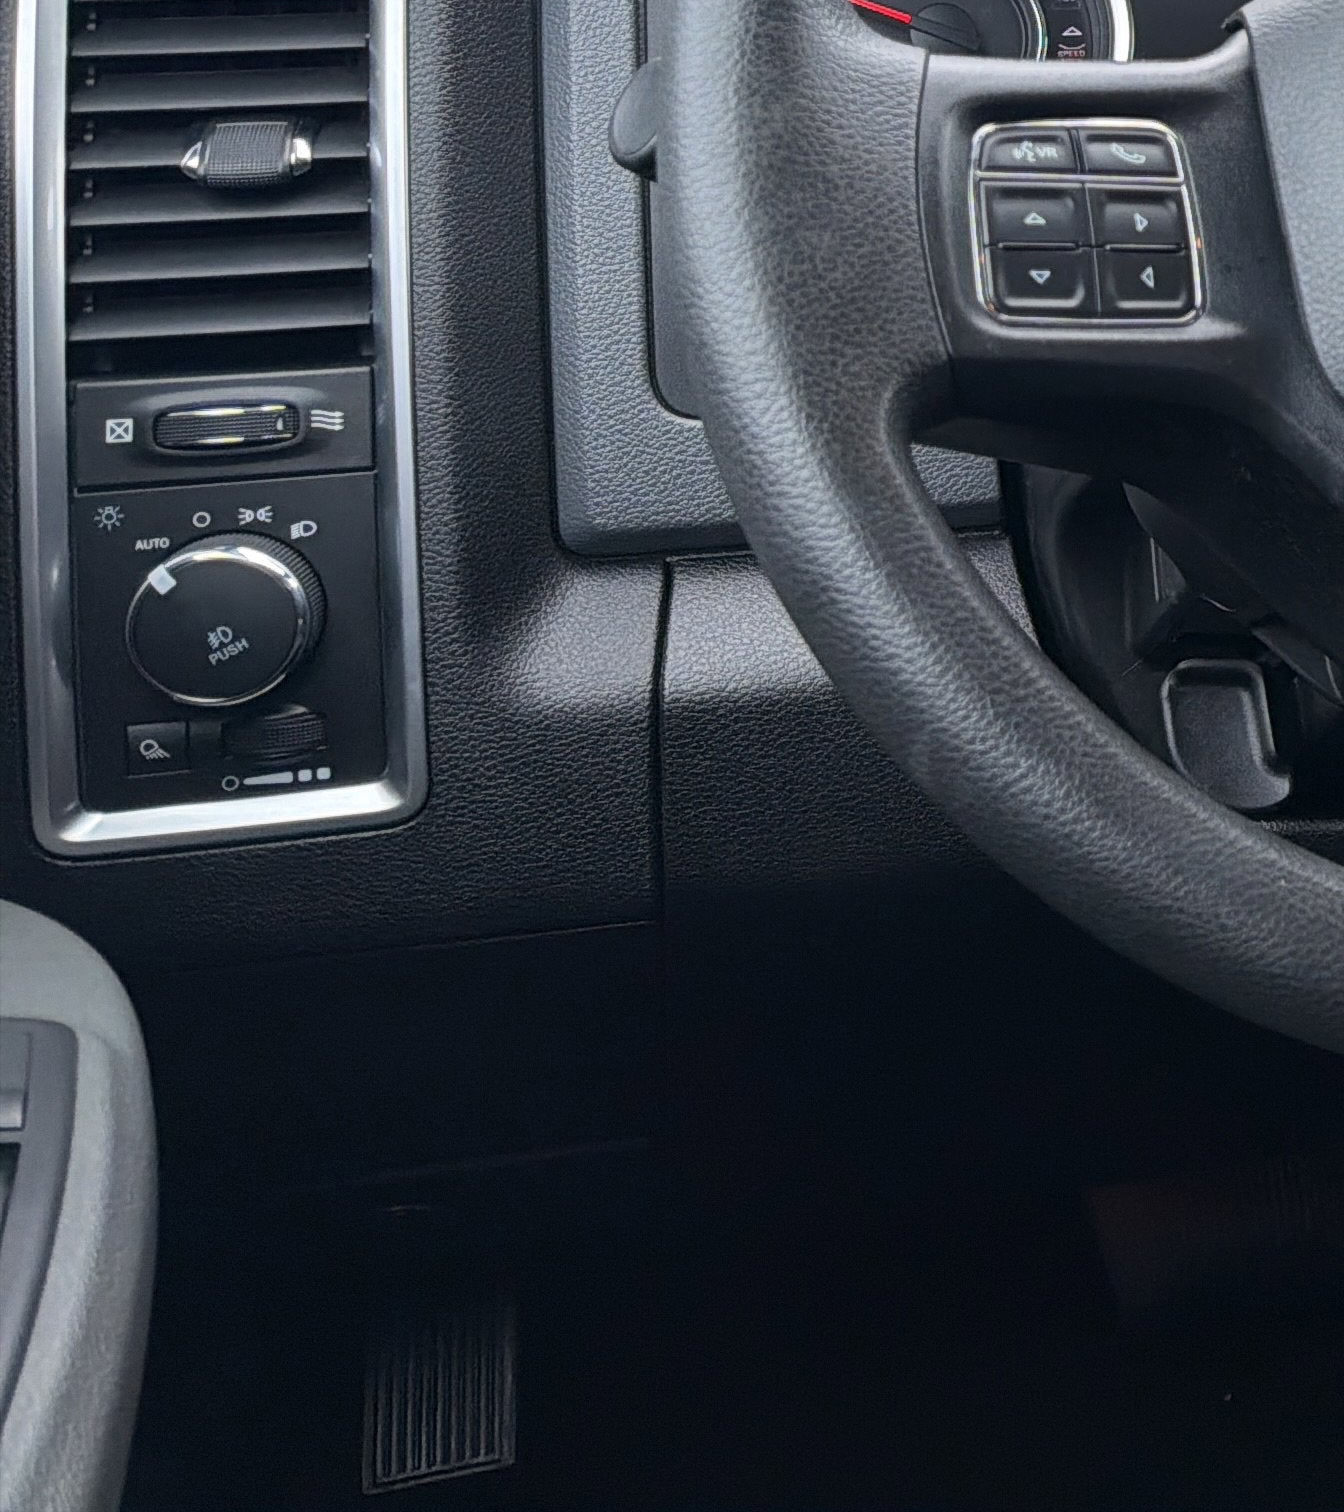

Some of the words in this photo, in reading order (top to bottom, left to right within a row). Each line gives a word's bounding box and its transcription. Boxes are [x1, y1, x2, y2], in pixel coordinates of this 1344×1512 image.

[1036, 145, 1058, 159] VR
[135, 536, 170, 552] AUTO
[208, 637, 250, 666] PUSH
